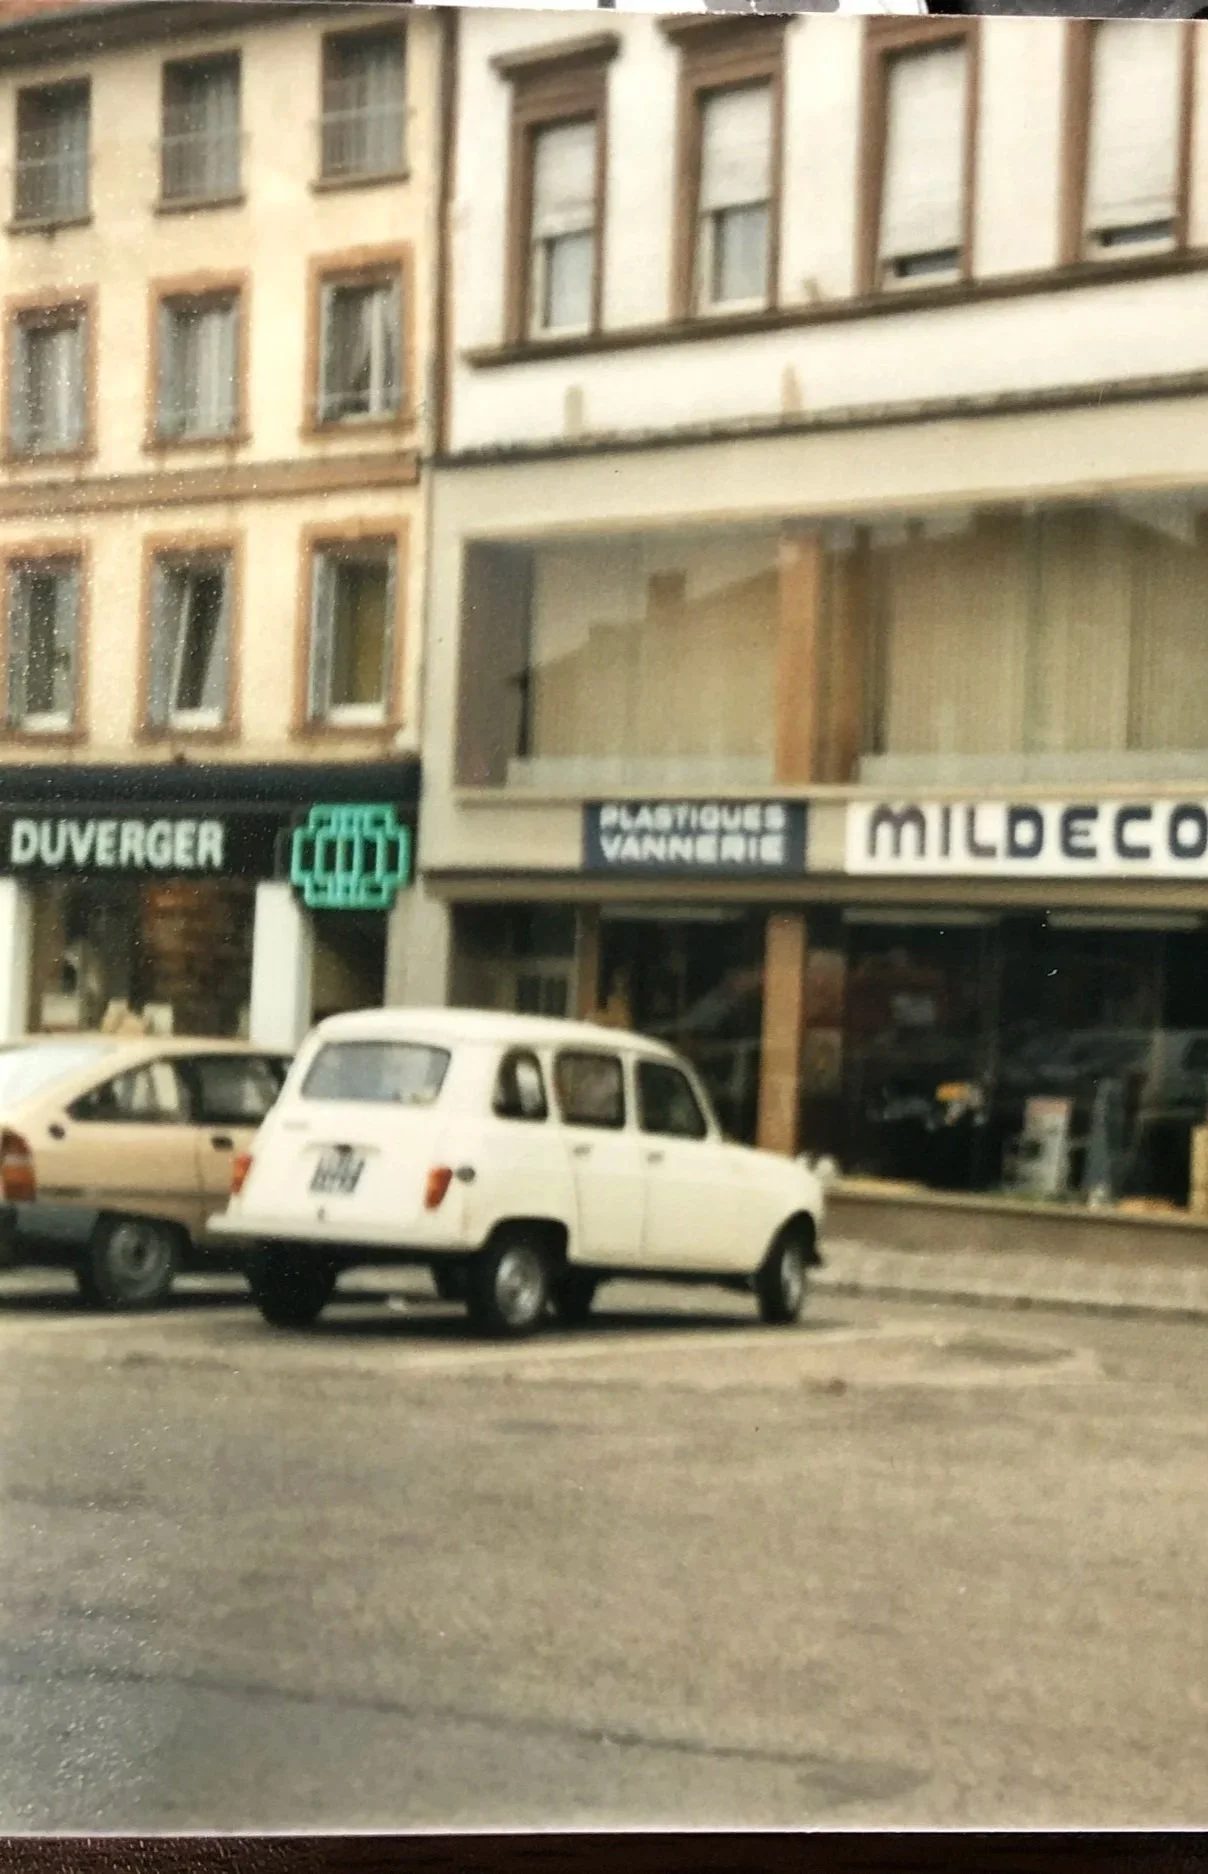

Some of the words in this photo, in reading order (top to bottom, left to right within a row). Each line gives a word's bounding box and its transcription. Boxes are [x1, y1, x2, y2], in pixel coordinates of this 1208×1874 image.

[599, 803, 787, 831] PLASTIQUES
[11, 819, 224, 868] DUVERGER
[600, 834, 784, 865] VANNERIE
